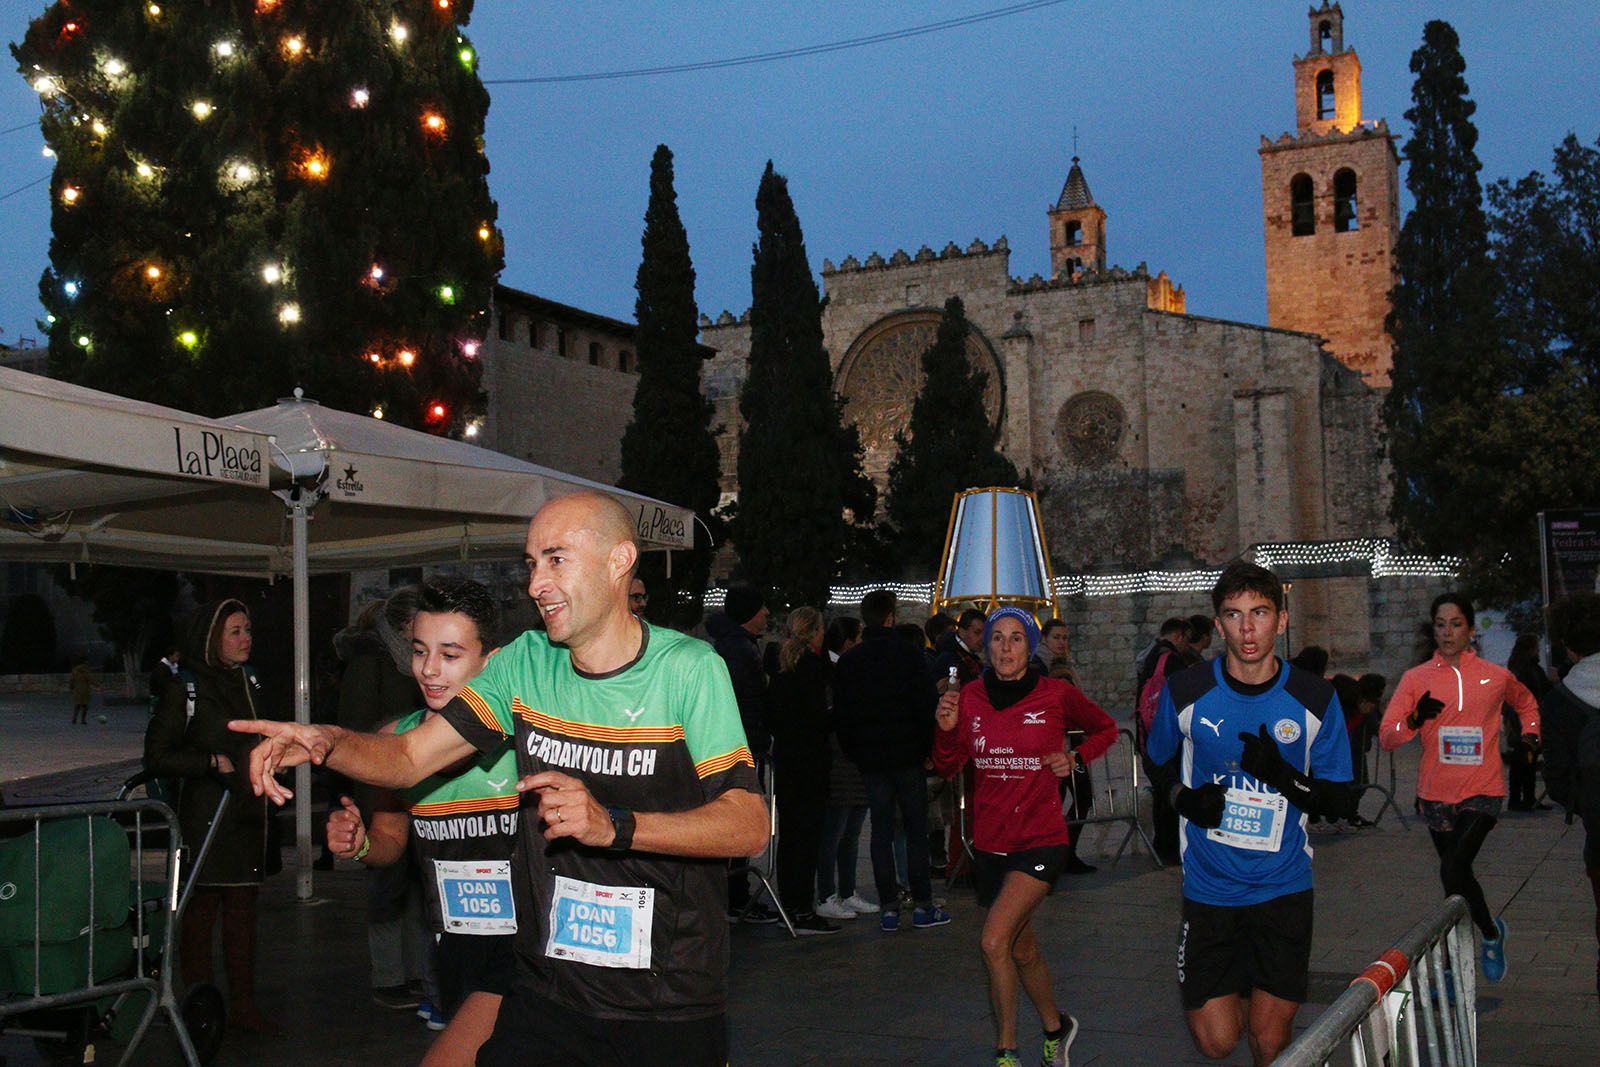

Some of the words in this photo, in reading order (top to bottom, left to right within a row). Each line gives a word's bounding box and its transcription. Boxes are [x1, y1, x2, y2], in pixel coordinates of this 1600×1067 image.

[336, 478, 364, 491] Estrella
[974, 736, 986, 753] 19
[627, 749, 657, 776] CH
[994, 757, 1041, 765] SILVESTRE
[1228, 804, 1262, 819] GORI
[414, 814, 498, 841] CRDANYOLA
[500, 811, 519, 836] CH
[1225, 817, 1261, 833] 1853
[457, 881, 497, 897] JOAN
[595, 890, 614, 899] SPORT
[460, 897, 502, 914] 1056
[638, 889, 647, 909] 1056
[567, 902, 616, 925] JOAN
[568, 922, 617, 948] 1056
